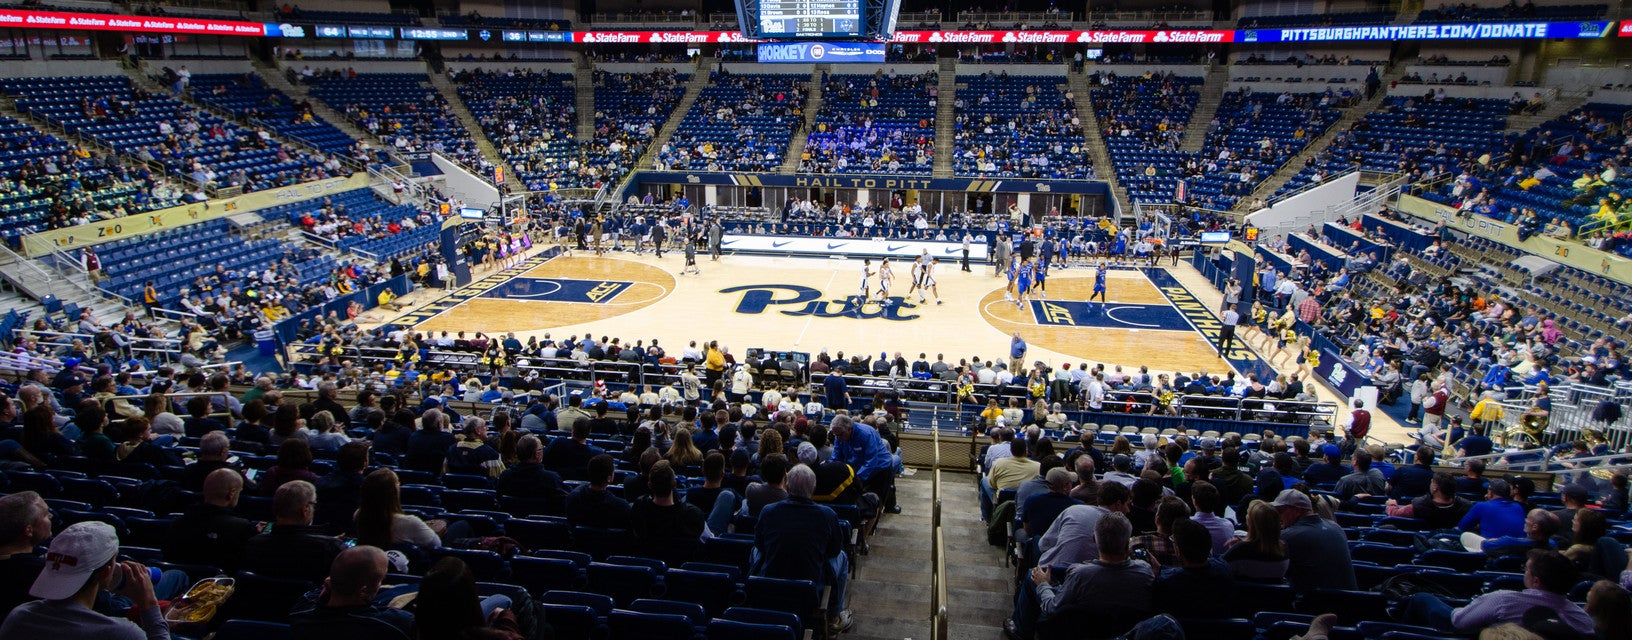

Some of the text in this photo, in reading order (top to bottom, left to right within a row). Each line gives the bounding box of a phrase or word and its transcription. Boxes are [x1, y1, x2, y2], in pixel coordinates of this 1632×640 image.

[323, 27, 339, 36] 64
[411, 29, 437, 38] 12:55
[509, 32, 520, 40] 36
[1281, 23, 1547, 41] PITTSBURGHPANTHERS.COM/DONATE
[758, 45, 808, 60] SHORKEY
[796, 178, 931, 189] HAIL TO PITT
[1479, 220, 1505, 237] PITT
[585, 281, 619, 302] ACC
[718, 284, 920, 321] Pitt
[1045, 303, 1075, 326] ACC
